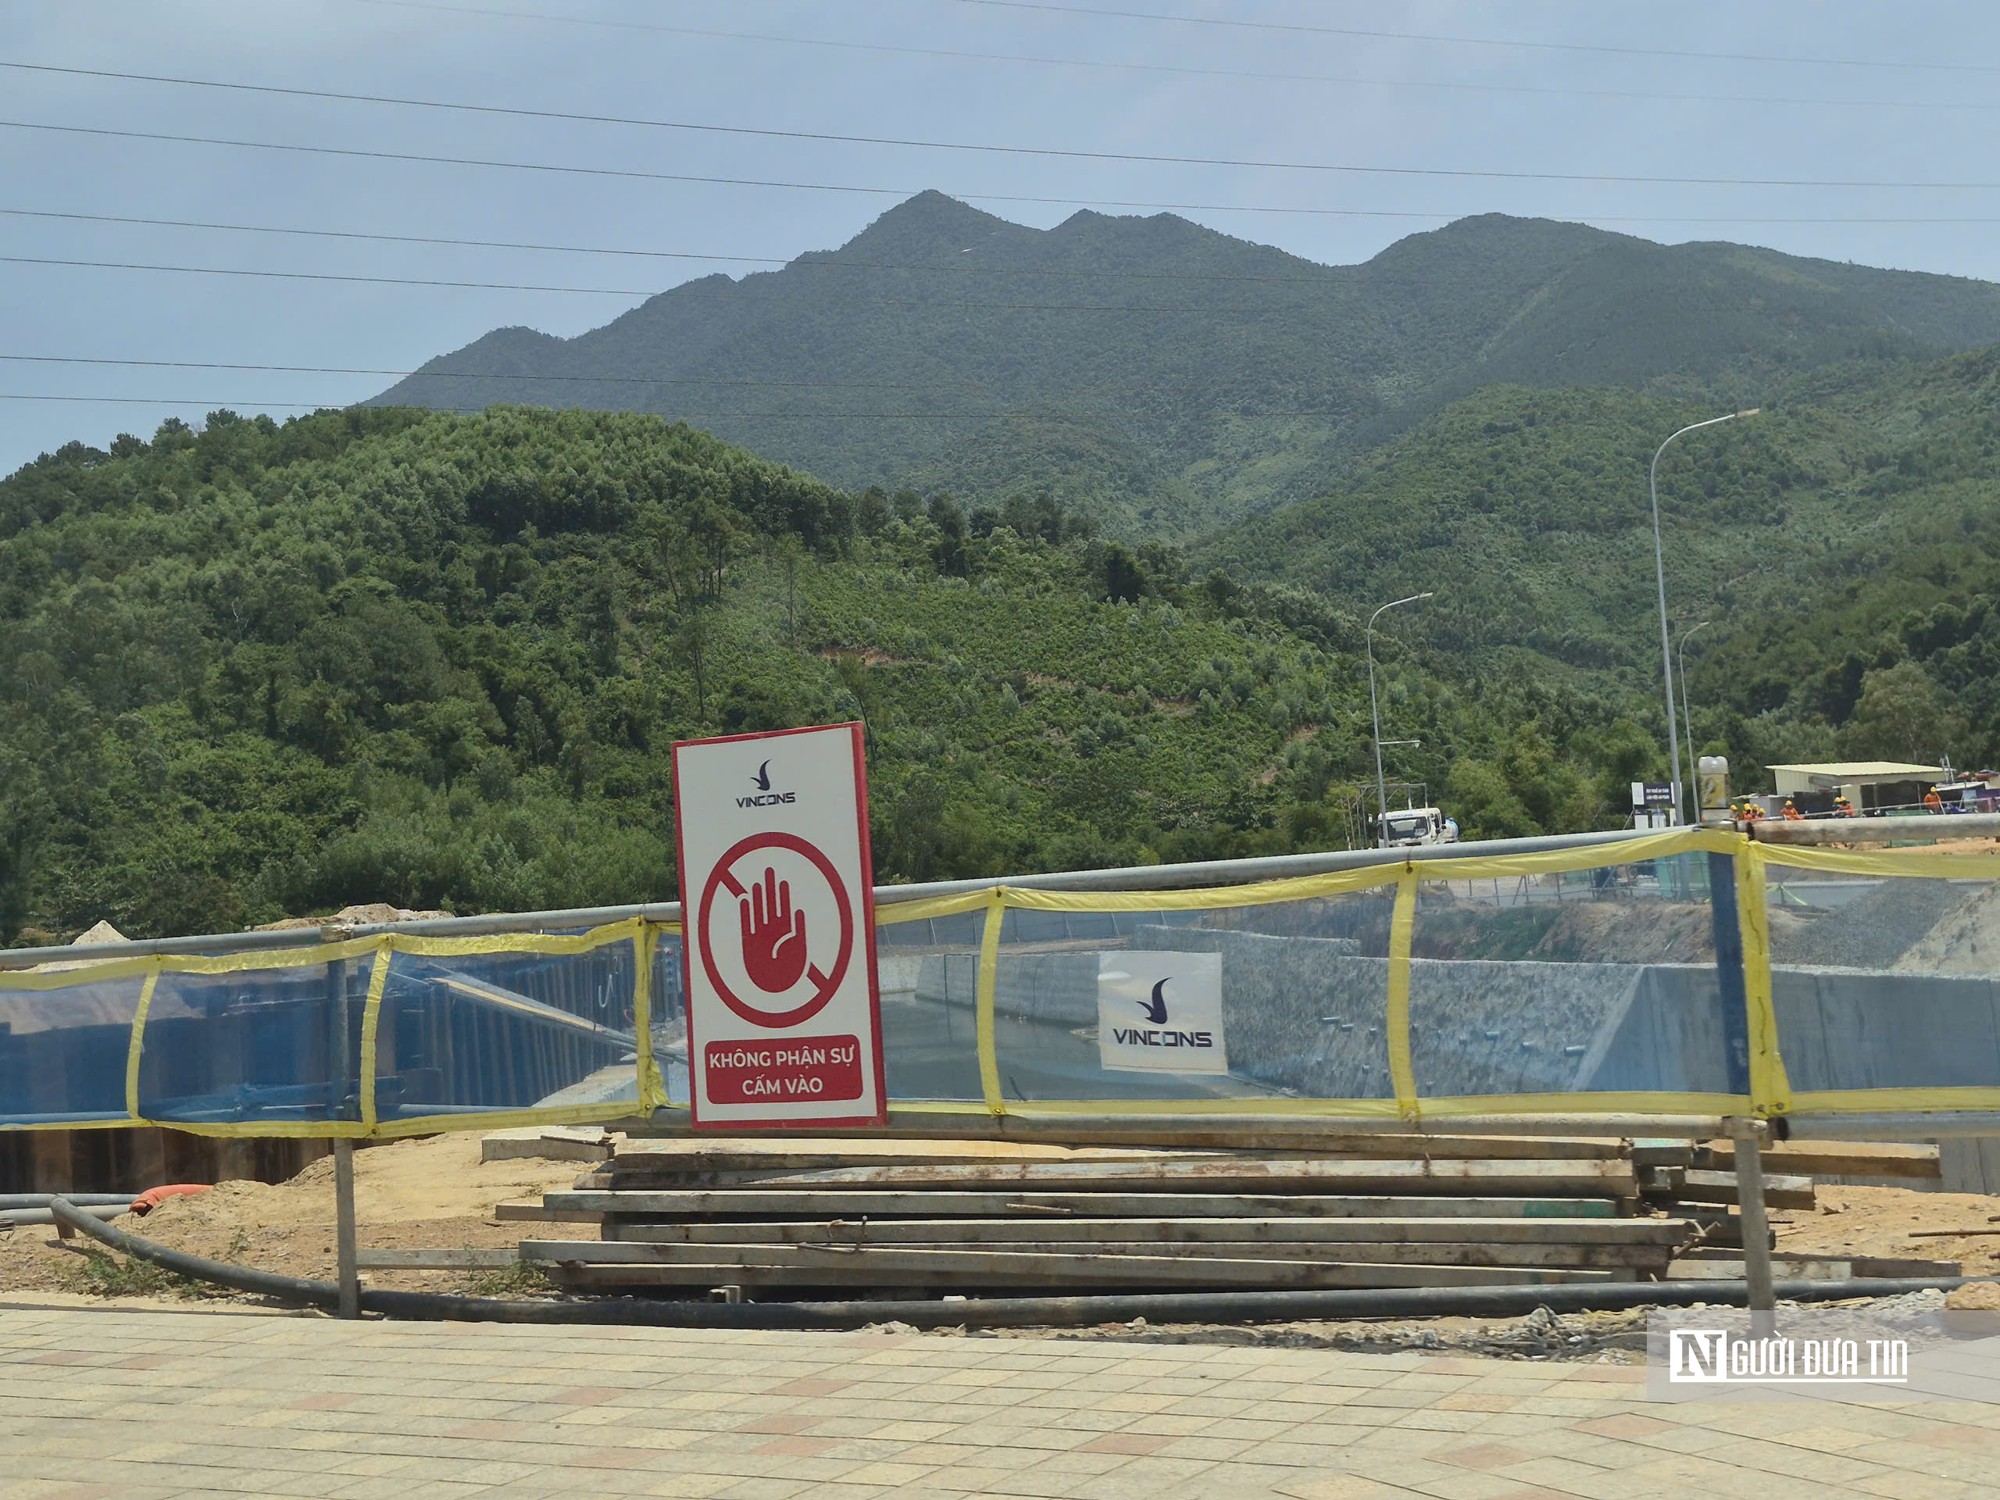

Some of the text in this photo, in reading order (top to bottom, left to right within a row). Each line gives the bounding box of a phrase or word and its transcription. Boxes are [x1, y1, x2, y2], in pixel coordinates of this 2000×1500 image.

[736, 792, 796, 808] VINCONS
[1113, 1028, 1212, 1047] VINCONS
[709, 1044, 855, 1069] KHÔNG PHẬN SỰ
[742, 1074, 823, 1095] CẤM VÀO
